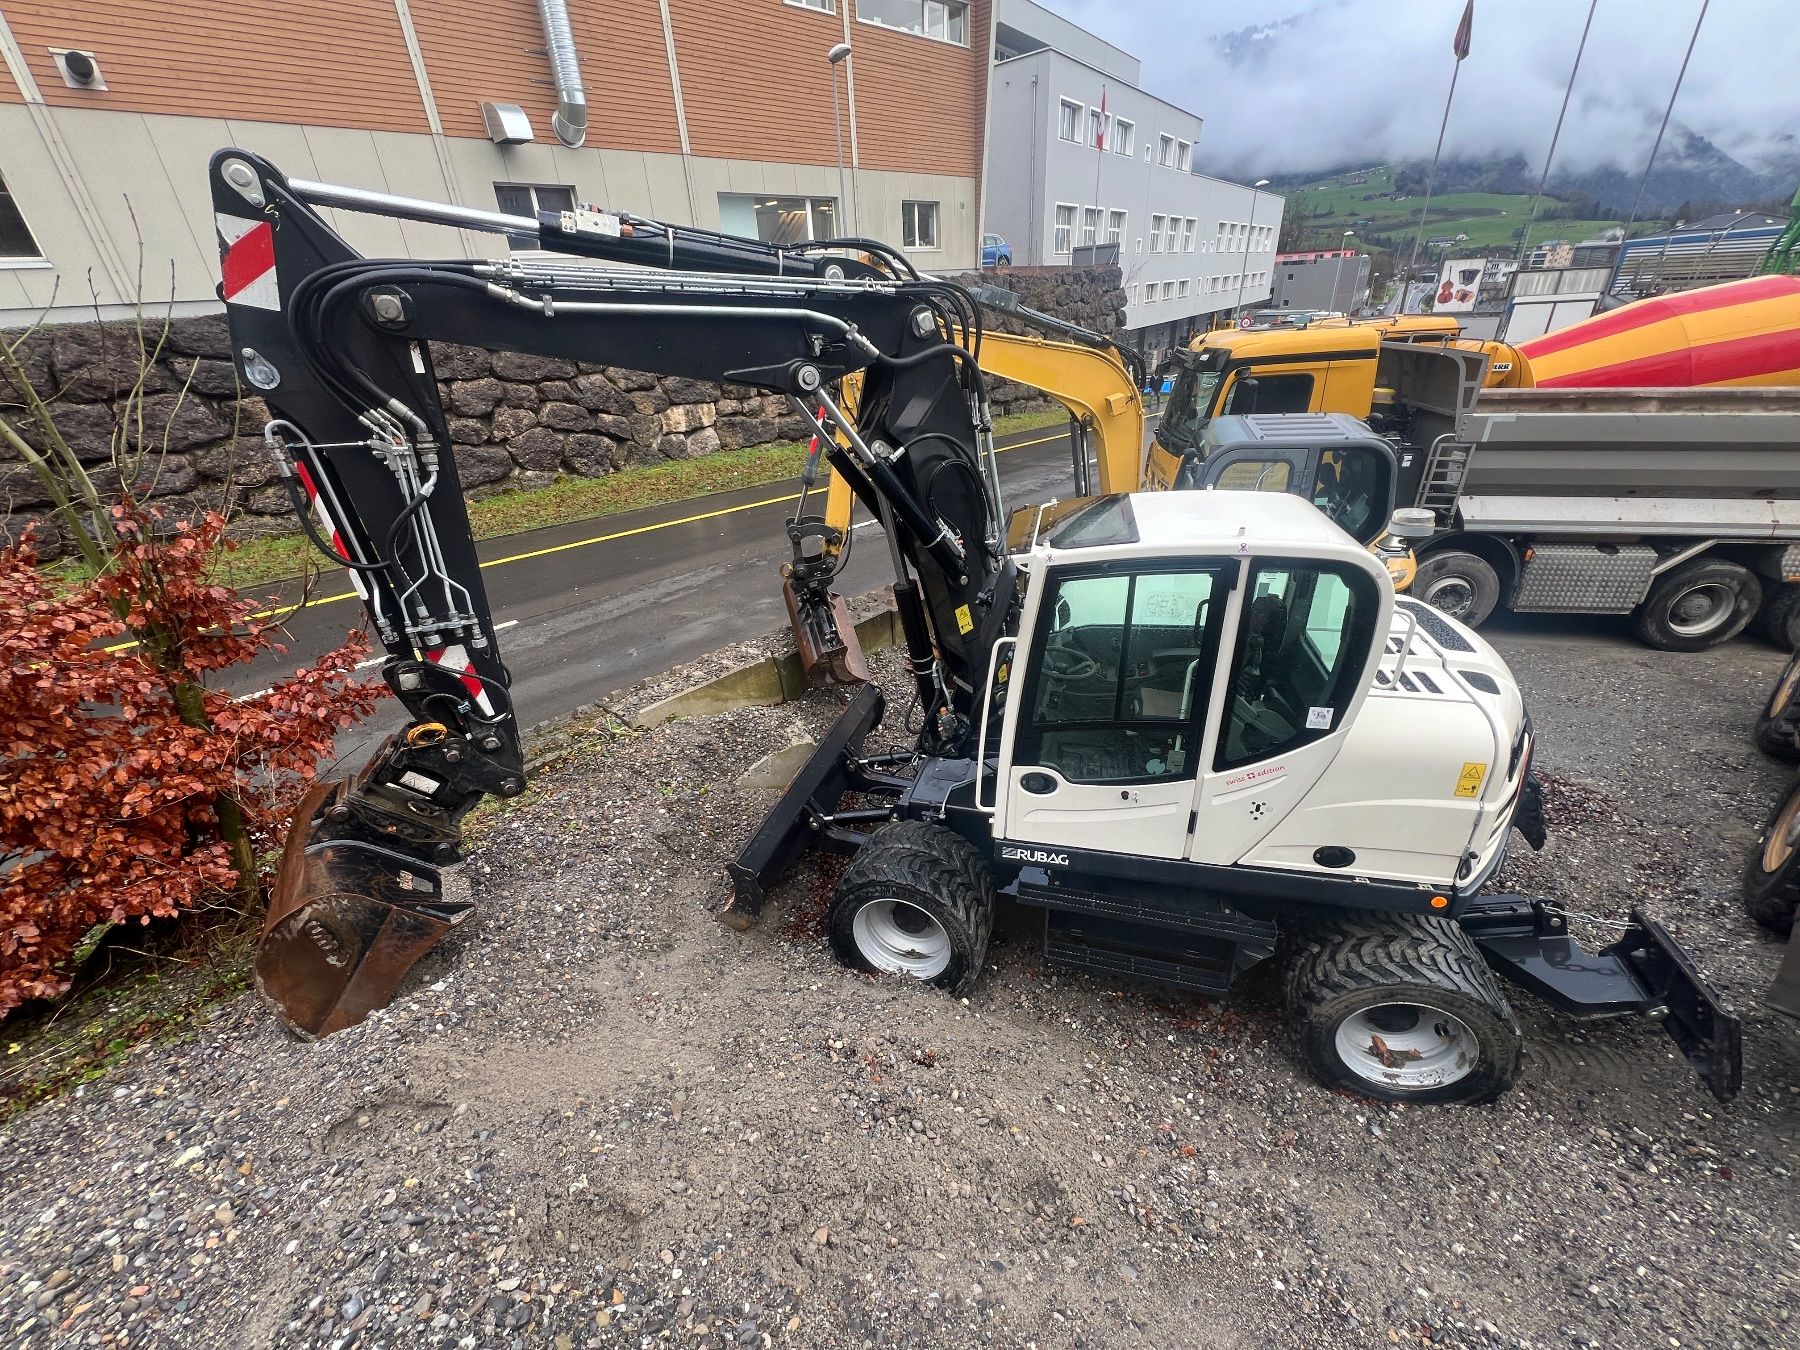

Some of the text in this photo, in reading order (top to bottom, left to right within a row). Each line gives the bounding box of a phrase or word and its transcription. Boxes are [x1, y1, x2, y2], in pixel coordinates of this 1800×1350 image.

[1226, 765, 1286, 785] swiss edition
[1017, 848, 1069, 866] RUBAG
